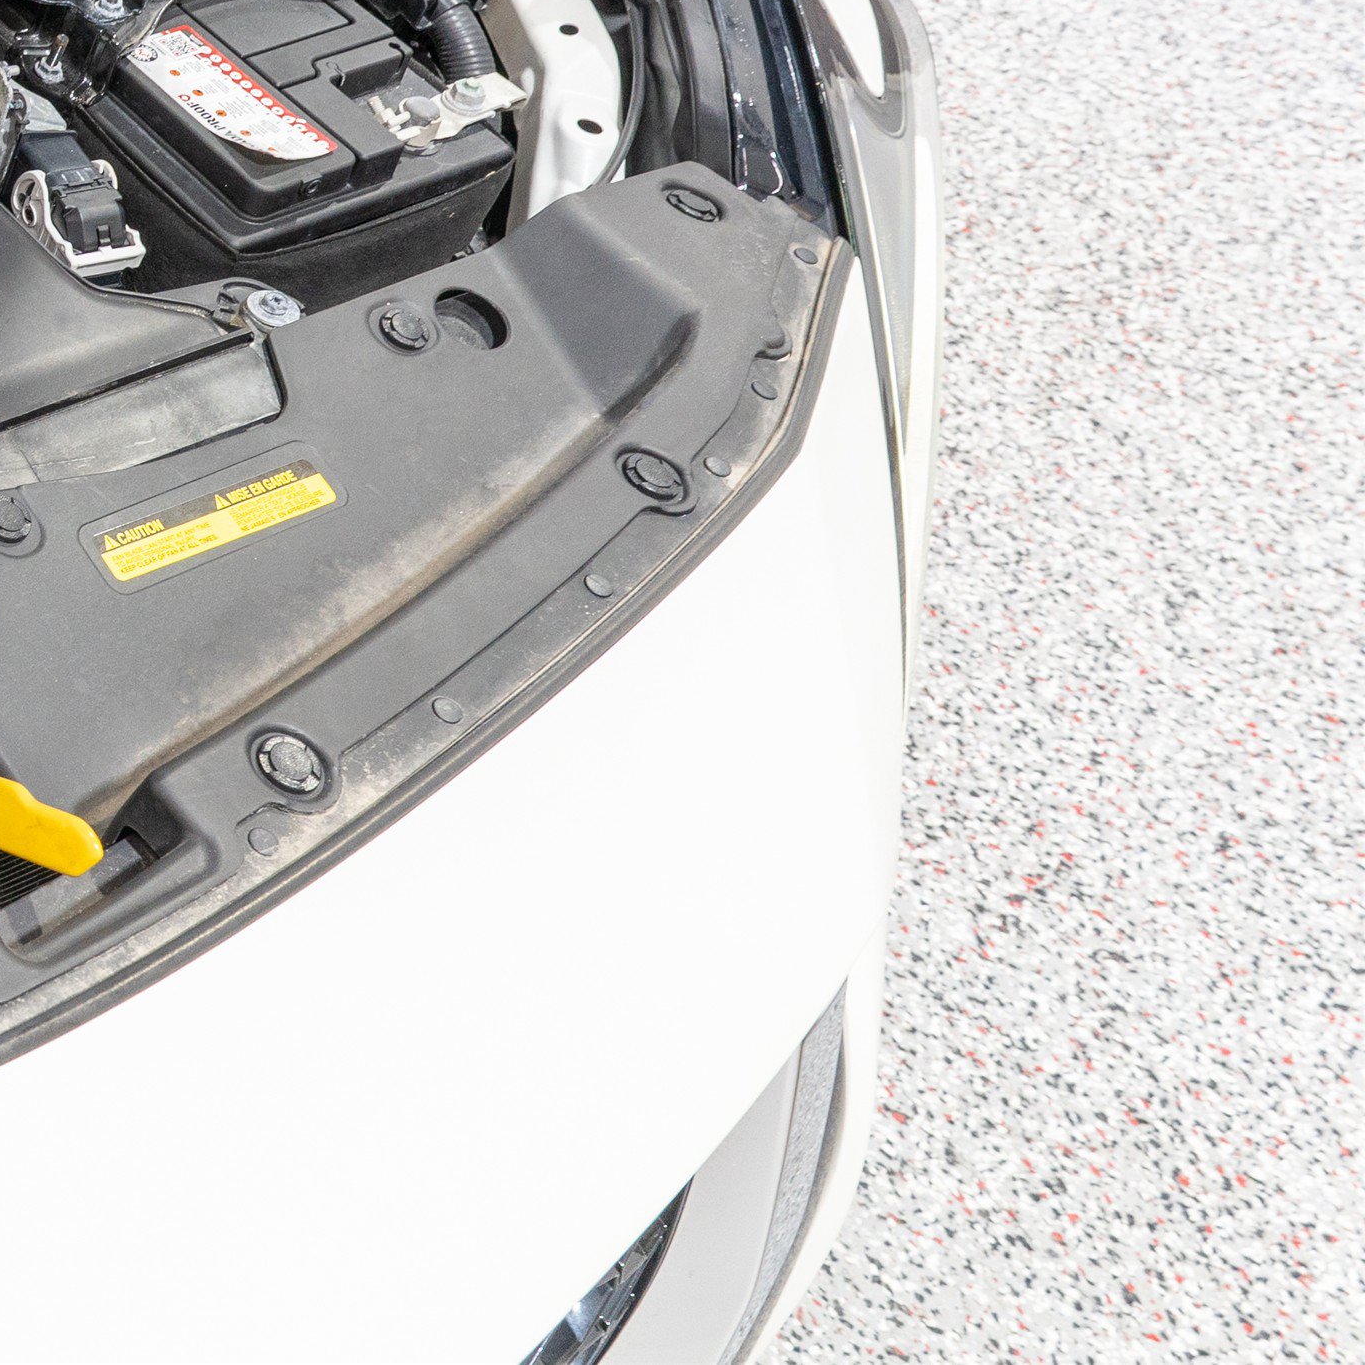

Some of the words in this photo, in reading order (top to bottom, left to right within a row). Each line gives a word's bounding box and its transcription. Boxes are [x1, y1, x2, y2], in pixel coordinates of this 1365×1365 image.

[226, 486, 252, 503] MISE
[247, 480, 266, 496] EN
[262, 469, 297, 490] GARDE
[116, 518, 164, 544] CAUTION
[119, 563, 137, 574] KEEP
[135, 555, 157, 568] CLEAR
[156, 552, 166, 561] OF
[165, 547, 179, 557] FAN
[177, 544, 187, 552] AT
[186, 539, 199, 549] ALL
